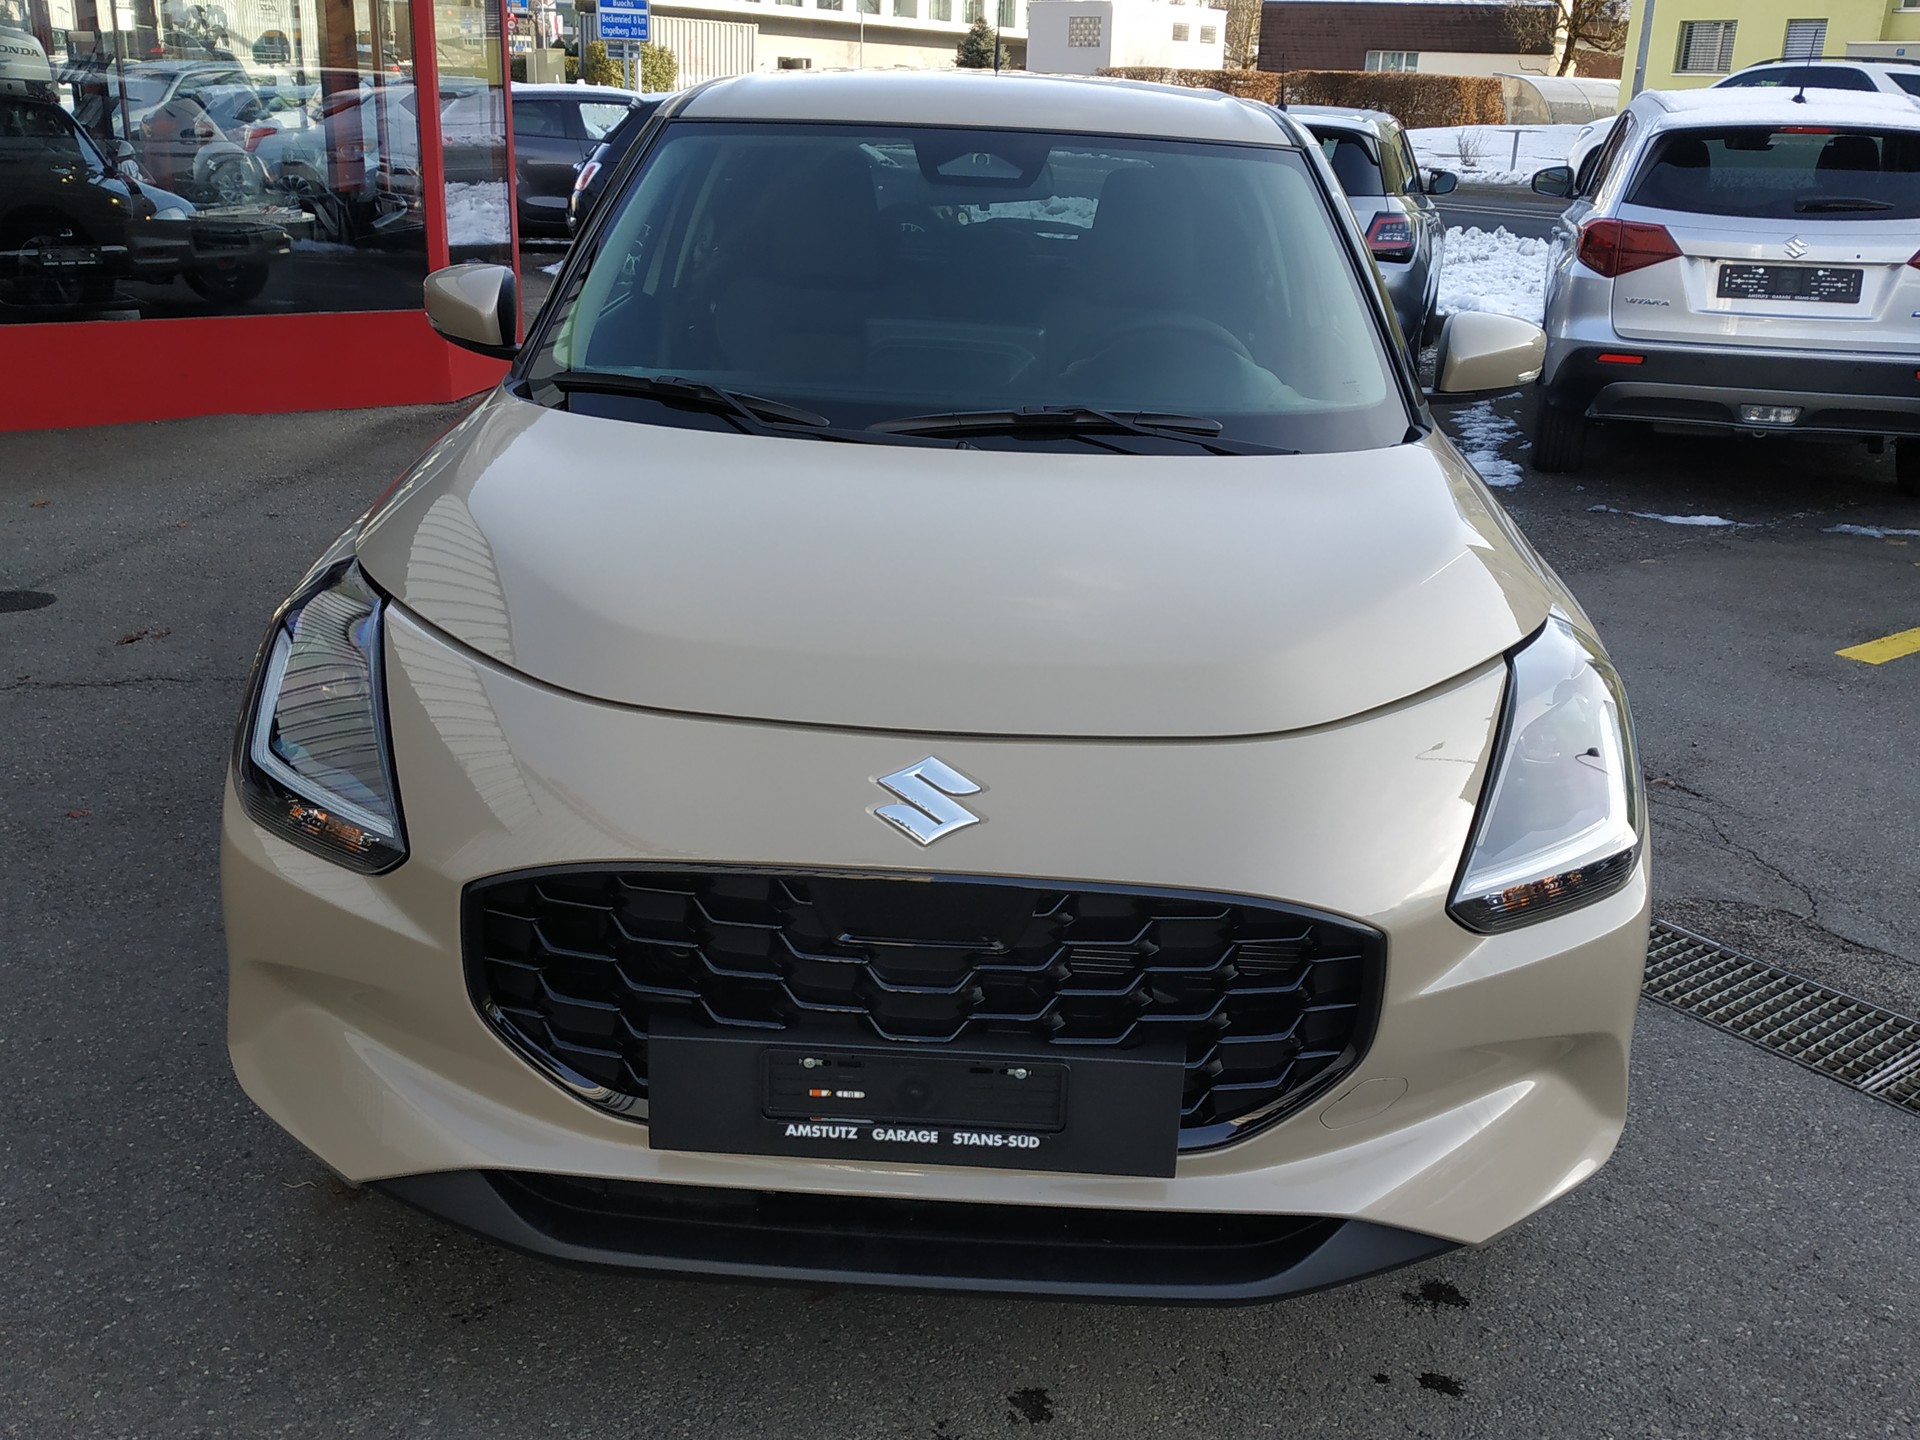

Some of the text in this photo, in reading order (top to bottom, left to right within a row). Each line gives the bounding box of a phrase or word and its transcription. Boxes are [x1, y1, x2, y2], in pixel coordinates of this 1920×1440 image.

[601, 14, 647, 25] Beckenried 8 km
[602, 25, 647, 37] Engelberg 20 km
[784, 1123, 1041, 1149] AMSTUTZ GARAGE STANS-SÜD
